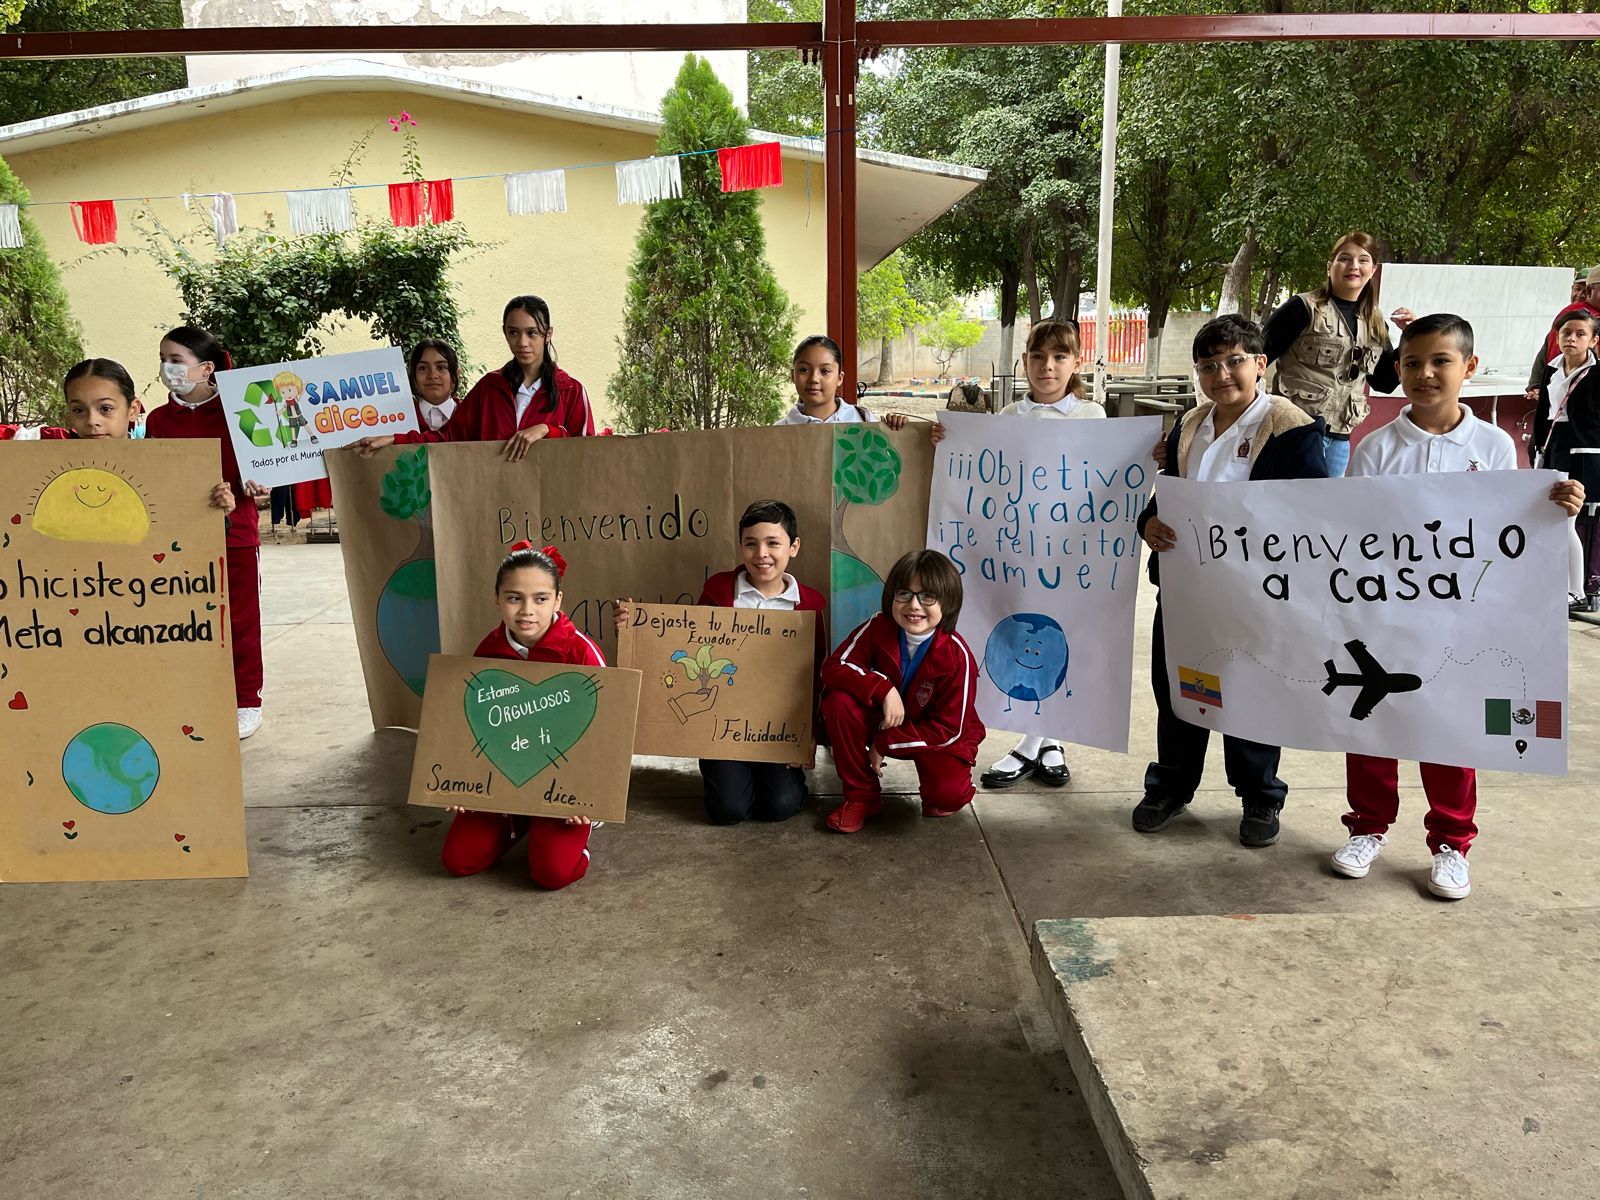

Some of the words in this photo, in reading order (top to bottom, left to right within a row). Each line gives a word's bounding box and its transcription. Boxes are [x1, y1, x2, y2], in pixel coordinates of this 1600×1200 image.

[305, 371, 401, 406] SAMUEL
[314, 405, 406, 434] dice...
[250, 458, 274, 469] Todos
[275, 455, 289, 467] por
[290, 453, 299, 462] el
[300, 448, 325, 460] Mund
[498, 493, 709, 544] Bienvenido
[995, 527, 1138, 558] felicito!
[949, 544, 1118, 591] Samuel
[1262, 573, 1290, 601] a
[84, 604, 226, 649] alcanzada!
[708, 611, 723, 632] tu
[731, 611, 772, 636] huella
[781, 627, 797, 639] en
[687, 630, 749, 651] Ecuador!
[477, 684, 520, 703] Estamos
[510, 734, 530, 752] de
[538, 727, 551, 745] ti
[427, 764, 492, 796] Samuel
[543, 778, 595, 807] dice...
